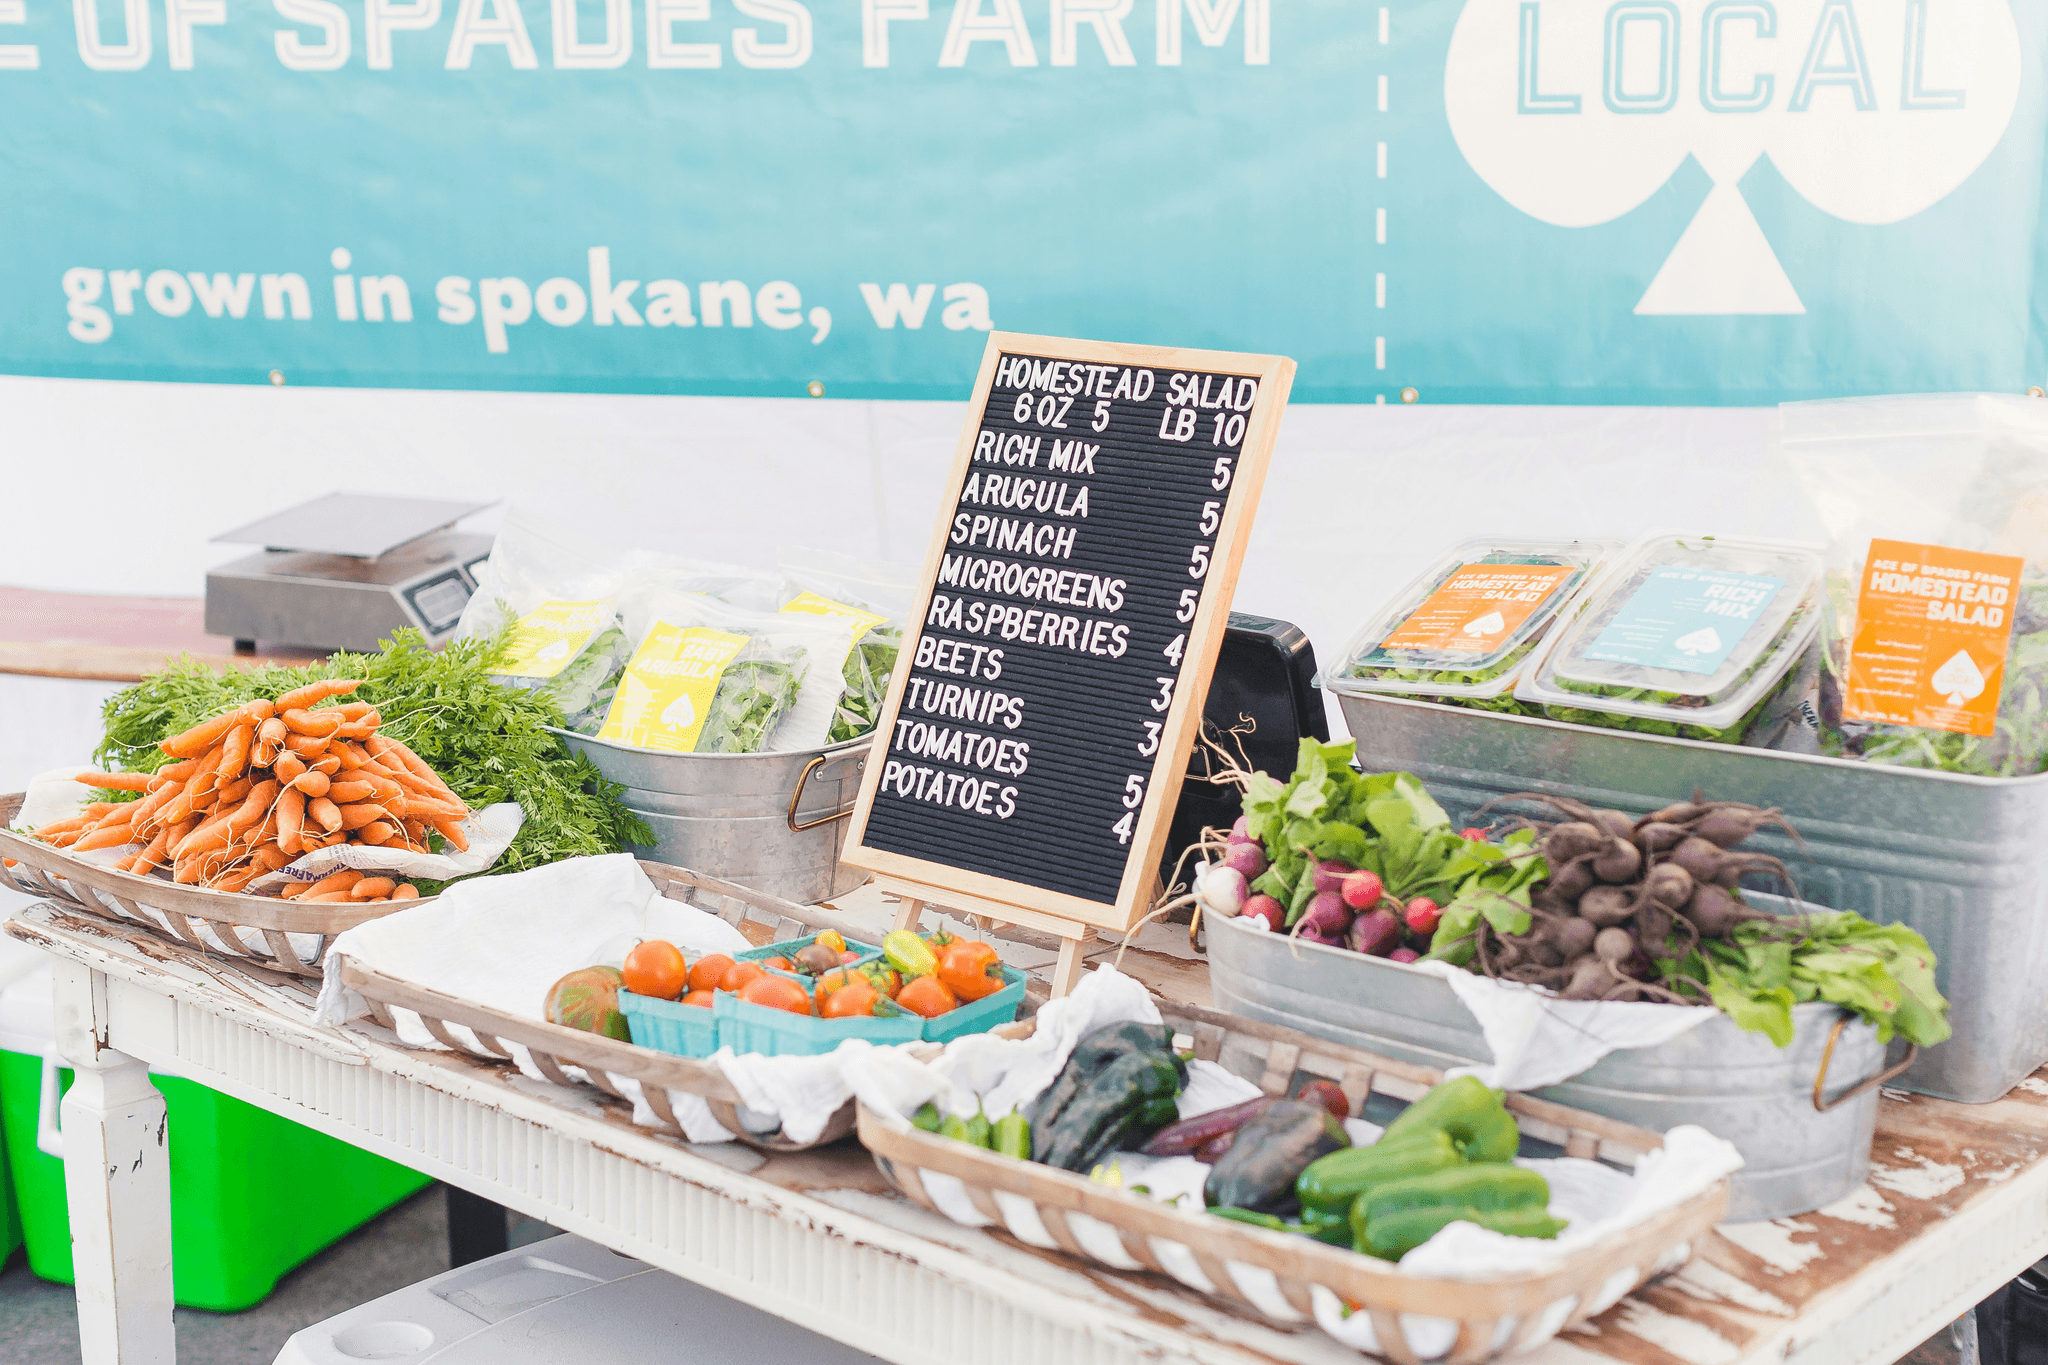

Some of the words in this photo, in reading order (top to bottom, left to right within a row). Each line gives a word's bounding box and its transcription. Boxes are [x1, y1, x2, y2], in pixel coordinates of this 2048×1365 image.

[73, 0, 227, 71] OF
[272, 0, 813, 71] SPADES
[861, 0, 1271, 68] FARM
[1517, 0, 1966, 115] LOCAL
[62, 267, 312, 343] grown
[330, 247, 413, 322] in
[436, 246, 832, 353] spokane,
[858, 281, 994, 331] wa
[995, 356, 1155, 402] HOMESTEAD
[1166, 373, 1258, 412] SALAD
[1091, 400, 1112, 433] 5
[1158, 406, 1198, 442] LB
[1212, 412, 1246, 447] 10
[974, 430, 1041, 467] RICH
[1048, 438, 1100, 475] MIX
[1211, 457, 1232, 491] 5
[961, 472, 1089, 518] ARUGULA
[1199, 501, 1221, 536] 5
[950, 513, 1078, 559] SPINACH
[1188, 545, 1209, 579] 5
[938, 553, 1127, 613] MICROGREENS
[1176, 589, 1198, 623] 5
[1448, 580, 1552, 592] HOMESTEAD
[1481, 590, 1542, 602] SALAD
[1703, 584, 1769, 605] RICH
[1703, 599, 1758, 620] MIX
[1870, 571, 2009, 605] HOMESTEAD
[1926, 600, 2004, 628] SALAD
[679, 643, 733, 663] BABY
[927, 595, 1130, 658] RASPBERRIES
[1163, 634, 1185, 667] 4
[635, 657, 717, 680] ARUGULA
[914, 635, 1004, 680] BEETS
[1151, 677, 1175, 711] 3
[907, 677, 1024, 730] TURNIPS
[1137, 721, 1162, 757] 3
[896, 719, 1029, 777] TOMATOES
[1122, 774, 1144, 808] 5
[881, 761, 1018, 819] POTATOES
[1112, 812, 1134, 844] 4
